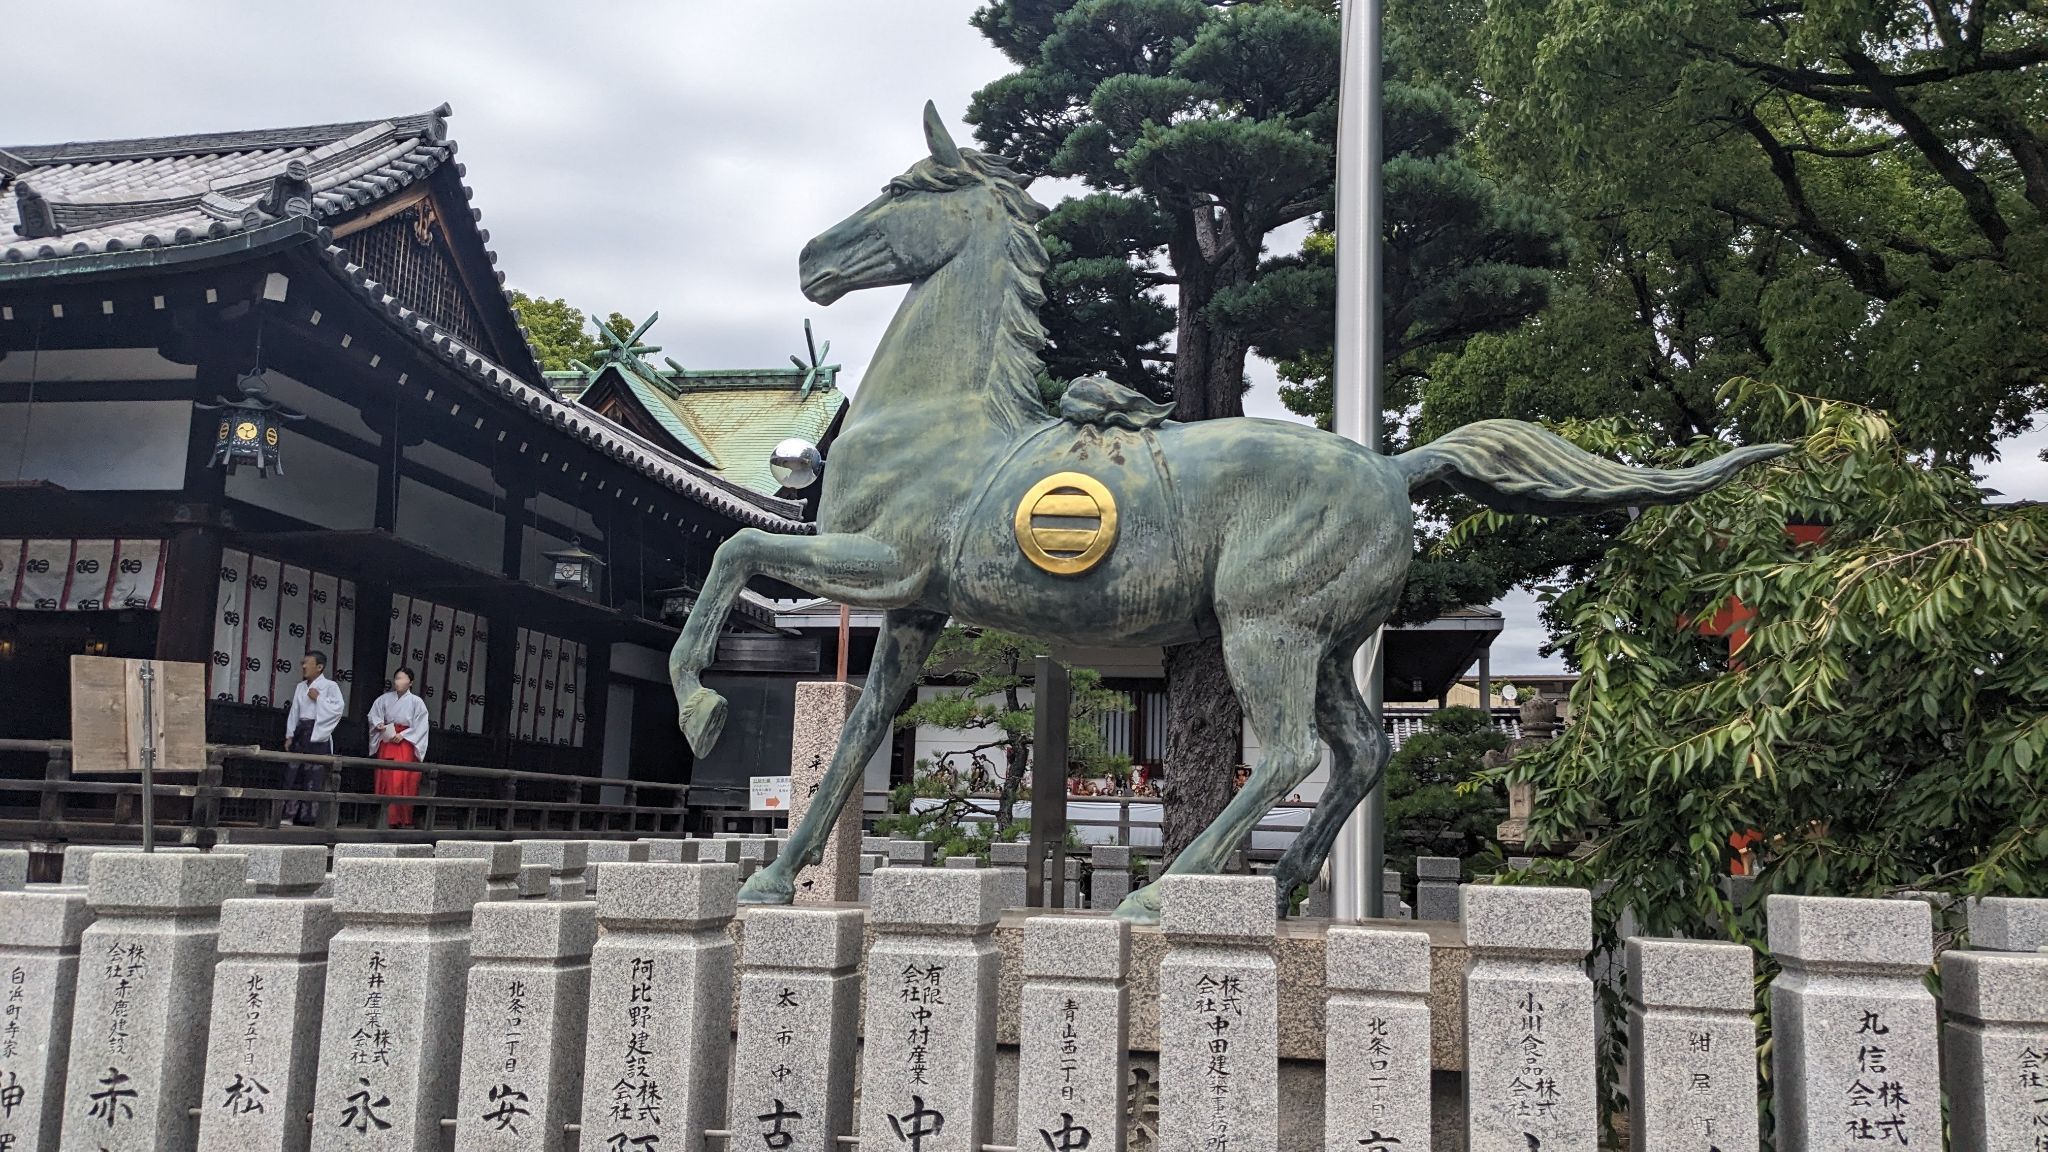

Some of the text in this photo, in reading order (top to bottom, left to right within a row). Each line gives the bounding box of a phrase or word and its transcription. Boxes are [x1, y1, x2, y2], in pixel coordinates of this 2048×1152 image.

[3, 966, 25, 1058] 白浜町寺家
[364, 951, 387, 1028] 永井産業
[901, 963, 923, 1003] 会社
[923, 963, 945, 1005] 有限
[1195, 974, 1219, 1015] 会社
[1219, 974, 1244, 1017] 株式
[505, 981, 526, 1073] 北条口一丁目
[624, 957, 654, 1078] 阿比野建設
[771, 988, 799, 1082] 太市中
[907, 1006, 932, 1085] 中村産業
[1518, 992, 1545, 1076] 小川食品
[1855, 1010, 1889, 1074] 丸信
[373, 1028, 392, 1067] 株式
[1060, 999, 1079, 1101] 青山西一丁目
[1367, 1017, 1391, 1119] 北条口一丁目
[222, 1074, 270, 1116] 松
[340, 1078, 392, 1133] 永
[482, 1083, 530, 1136] 安
[609, 1078, 636, 1122] 会社
[636, 1080, 662, 1125] 株式
[1507, 1076, 1534, 1118] 会社
[1535, 1077, 1561, 1122] 株式
[1688, 1032, 1715, 1137] 紺屋町
[1845, 1078, 1876, 1141] 会社
[1876, 1081, 1910, 1146] 株式
[757, 1099, 802, 1149] 古
